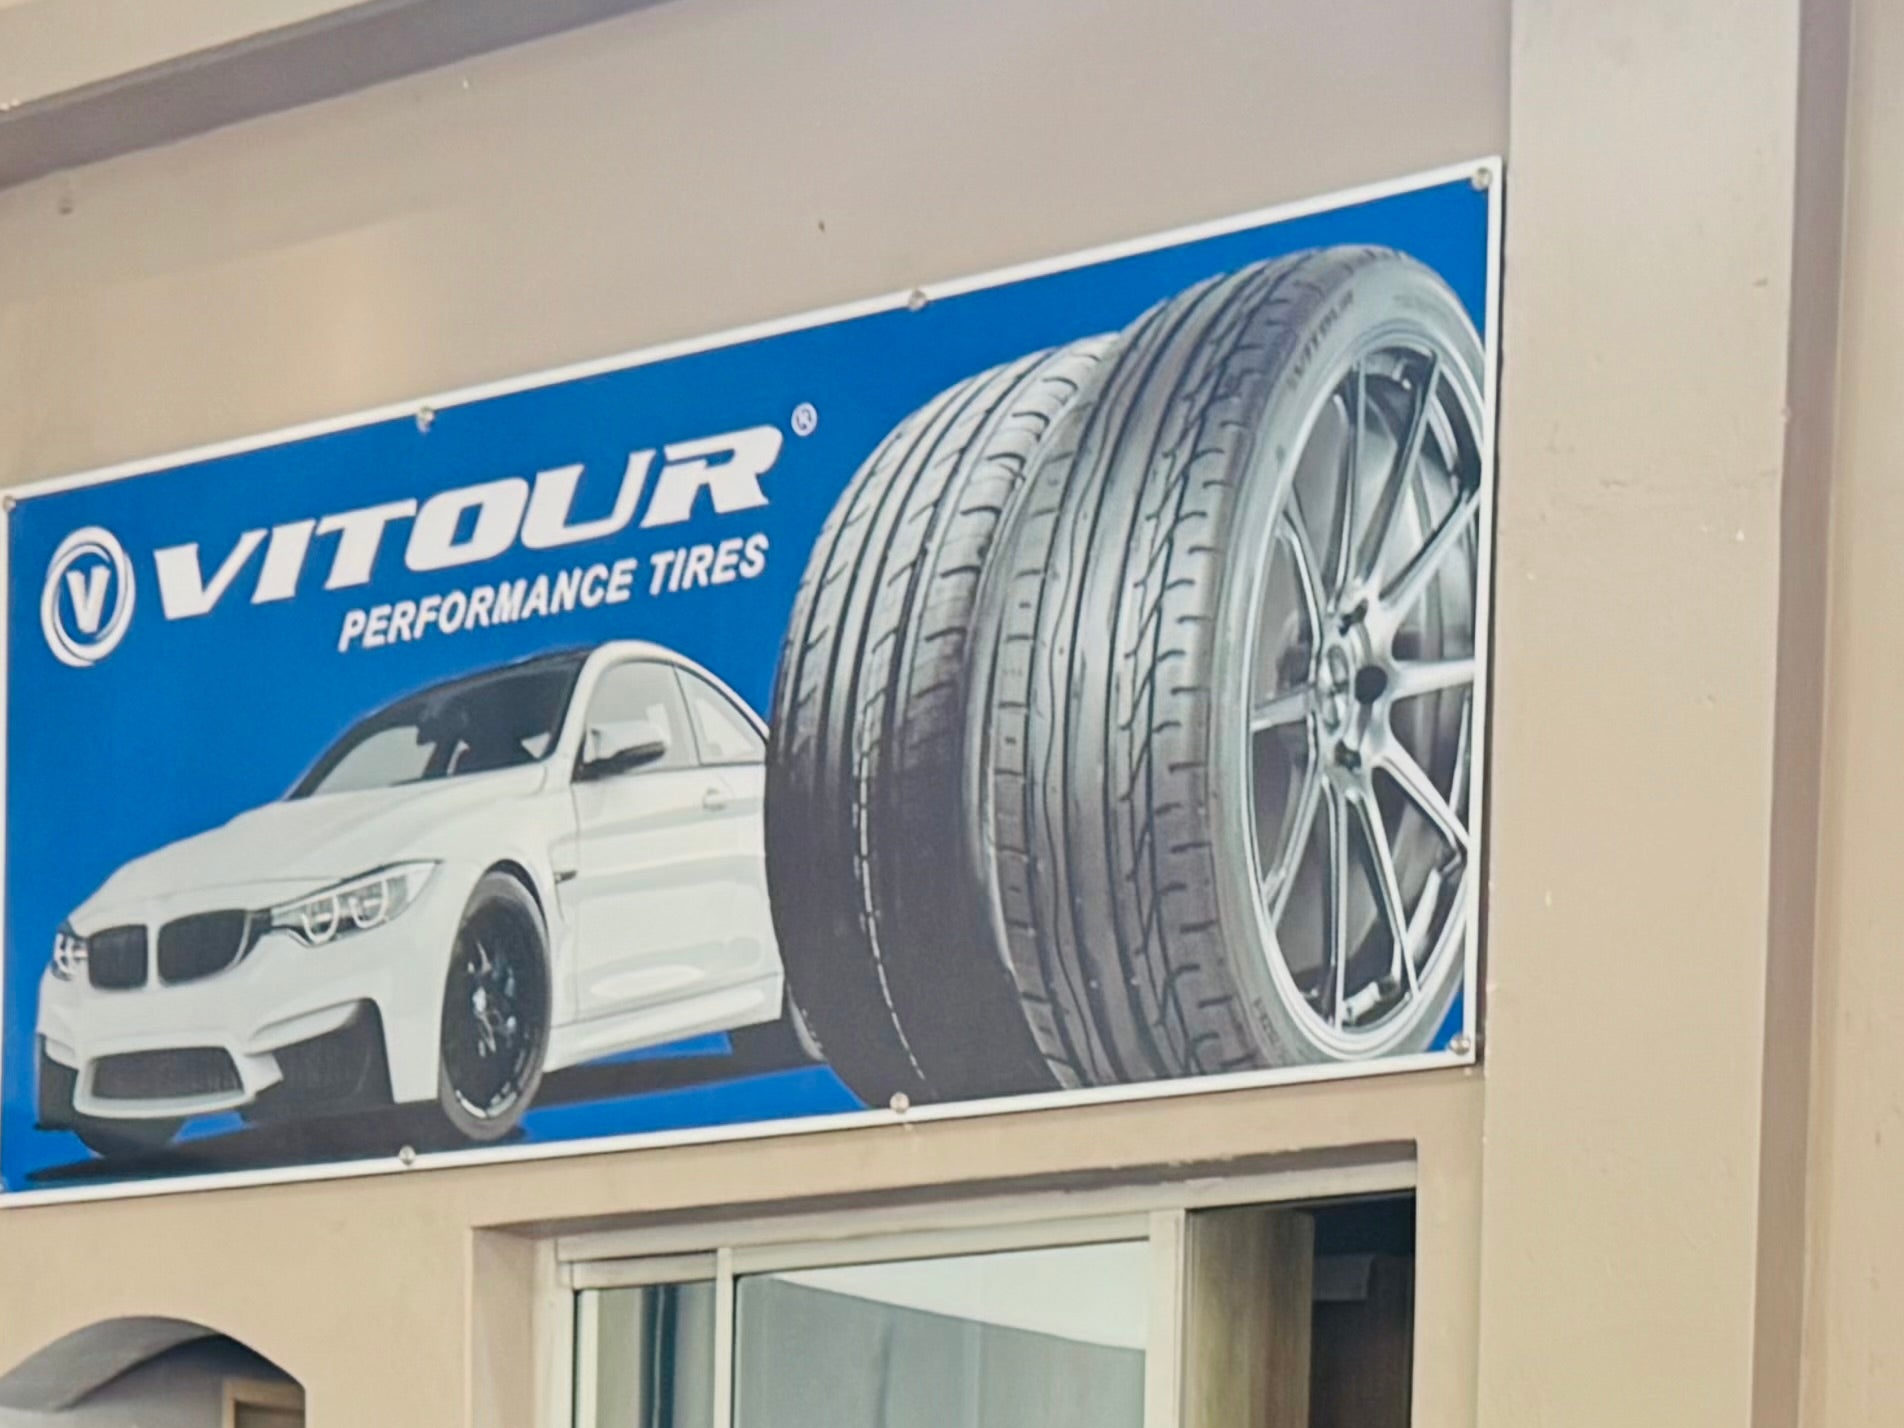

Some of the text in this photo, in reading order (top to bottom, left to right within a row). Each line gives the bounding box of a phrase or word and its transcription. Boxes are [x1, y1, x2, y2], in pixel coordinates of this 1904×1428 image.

[153, 424, 784, 622] VITOUR
[337, 532, 770, 653] PERFORMANCE TIRES
